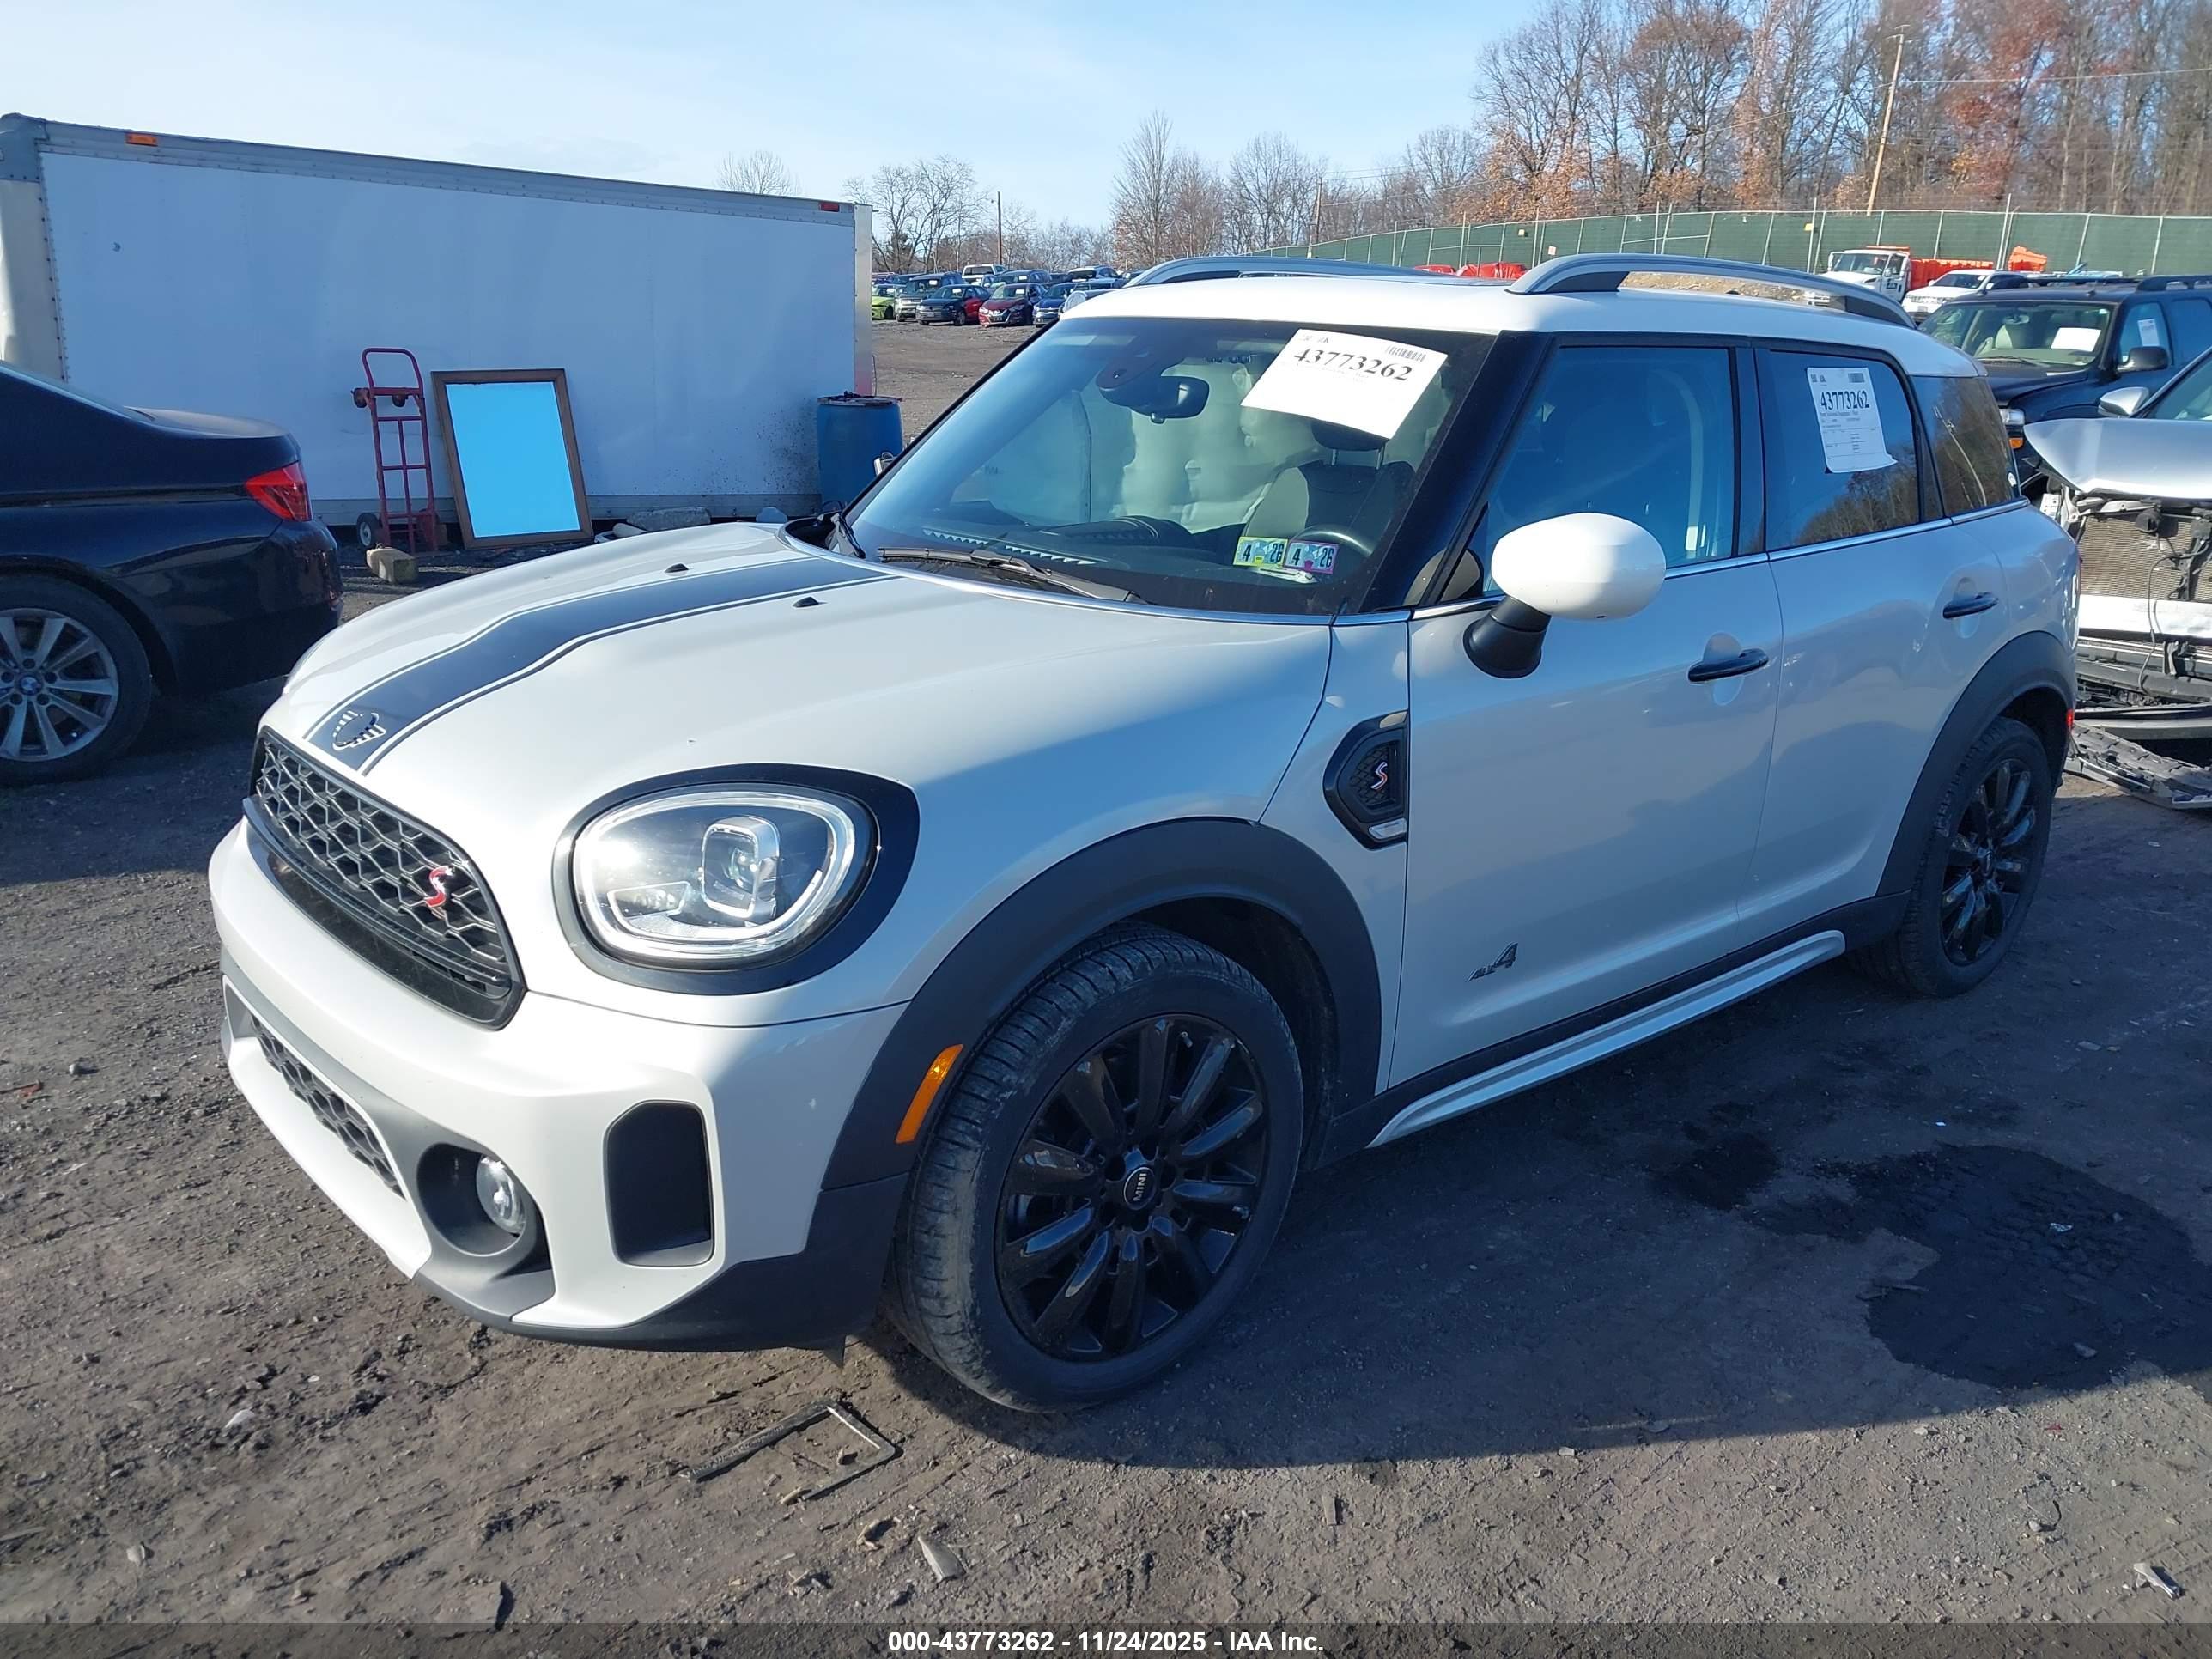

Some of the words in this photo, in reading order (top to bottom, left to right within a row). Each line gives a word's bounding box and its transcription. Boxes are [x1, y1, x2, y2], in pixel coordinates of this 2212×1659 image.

[1294, 348, 1413, 380] 43773262
[1820, 390, 1869, 410] 43773262
[1242, 544, 1252, 562] 4
[1270, 543, 1285, 562] 26
[1291, 548, 1302, 565] 4
[1319, 547, 1334, 567] 26
[1370, 761, 1388, 790] S
[423, 865, 453, 908] S
[1133, 1173, 1147, 1201] MINI
